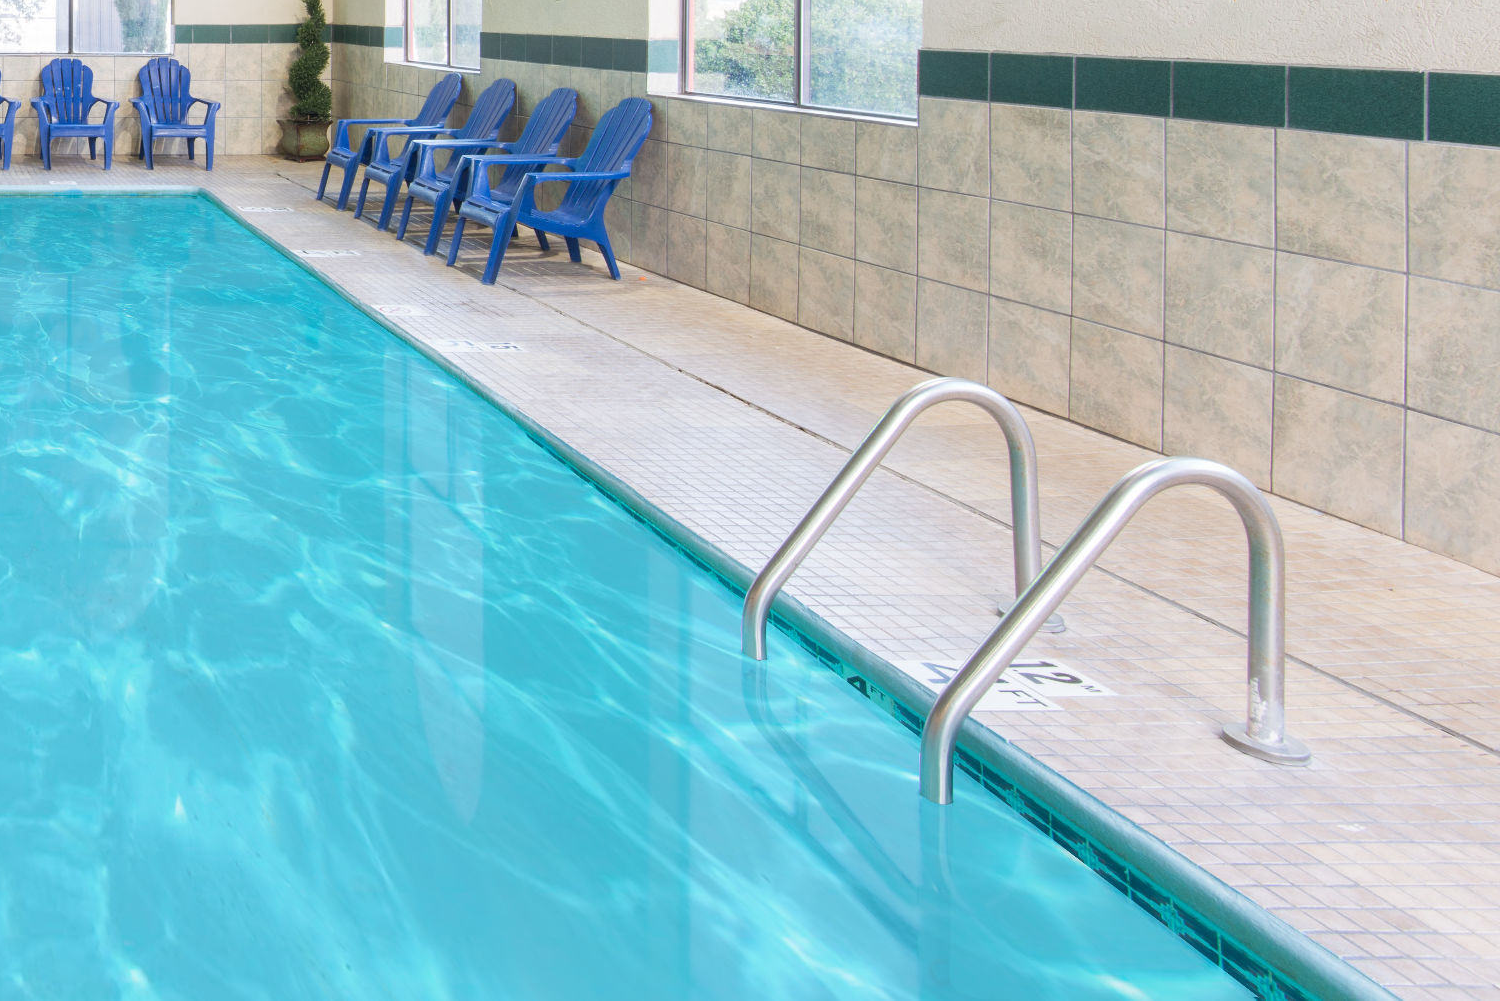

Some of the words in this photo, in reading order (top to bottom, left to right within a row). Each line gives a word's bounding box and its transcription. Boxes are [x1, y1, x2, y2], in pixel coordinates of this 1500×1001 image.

[846, 675, 871, 699] 4
[870, 686, 886, 701] FT
[1081, 685, 1103, 693] M
[998, 689, 1049, 707] FT
